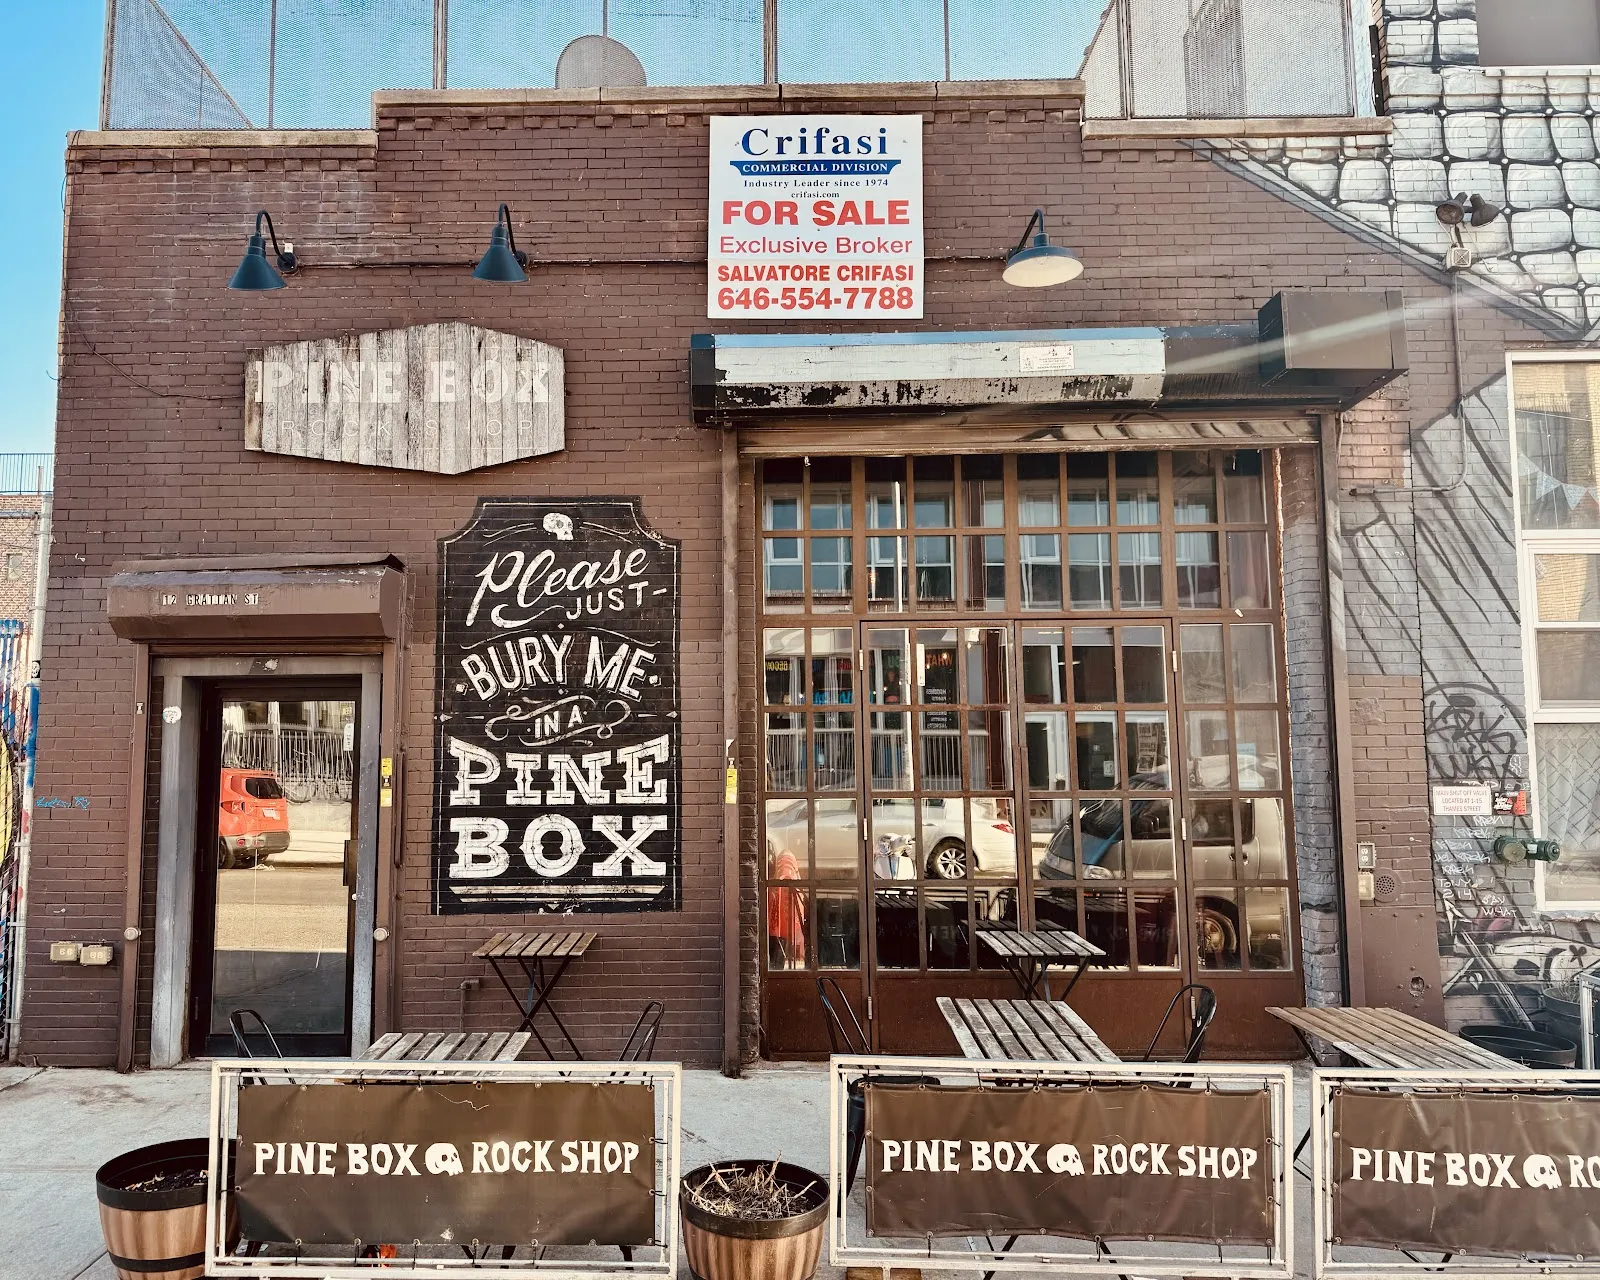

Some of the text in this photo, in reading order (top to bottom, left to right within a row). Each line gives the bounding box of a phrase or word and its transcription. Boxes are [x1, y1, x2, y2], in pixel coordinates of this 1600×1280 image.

[741, 127, 888, 156] Crifasi
[742, 163, 889, 173] COMMERCIAL DIVISION
[743, 178, 889, 189] Industry Leader since 1974
[791, 191, 840, 199] crifasi.com
[722, 200, 910, 227] FOR SALE
[720, 236, 913, 254] Exclusive Broker
[717, 265, 914, 281] SALVATORE CRIFASI
[717, 287, 914, 310] 646-554-7788
[254, 358, 550, 403] PINE BOX
[282, 420, 392, 436] ROCK
[163, 593, 258, 605] 12 GRATTAN ST
[466, 548, 650, 628] Please
[461, 633, 658, 702] BURY ME
[534, 705, 585, 738] IN A
[448, 734, 669, 806] PINE
[448, 813, 668, 878] BOX
[253, 1140, 640, 1177] PINE BOX ROCK SHOP
[881, 1139, 1257, 1180] PINE BOX ROCK SHOP
[1350, 1146, 1435, 1187] PINE
[1443, 1152, 1521, 1189] BOX
